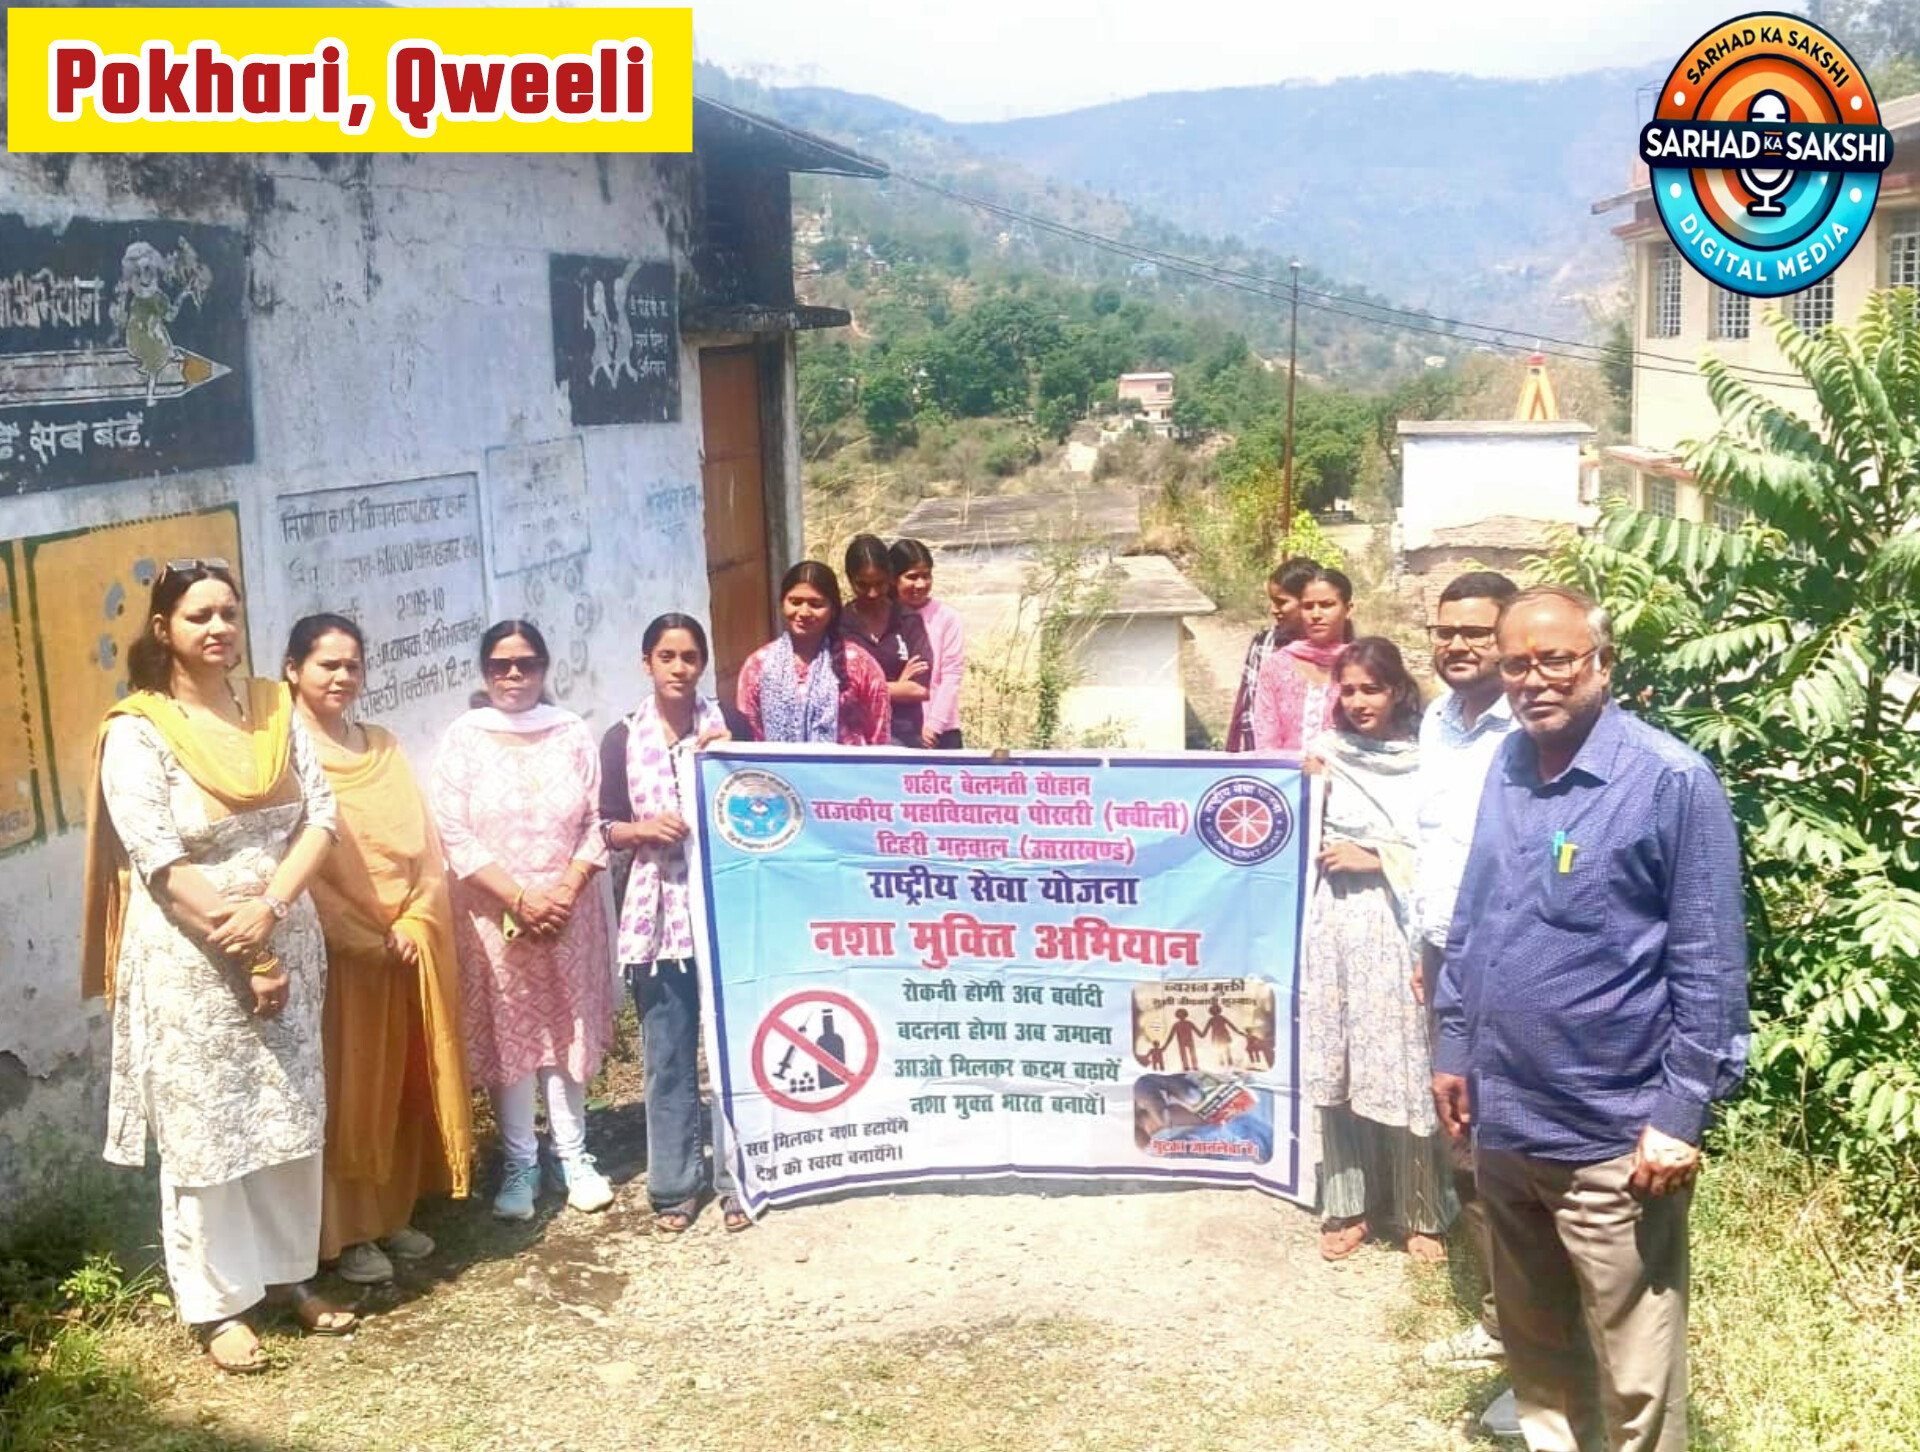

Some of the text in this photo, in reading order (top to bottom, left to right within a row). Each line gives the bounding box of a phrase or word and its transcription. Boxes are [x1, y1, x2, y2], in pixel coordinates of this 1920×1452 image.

[903, 773, 951, 796] शहीद
[1035, 771, 1090, 796] चौहान
[812, 798, 893, 822] राजकीय
[902, 798, 1019, 825] महाविद्यालय
[876, 831, 929, 856] टिहरी
[868, 865, 1140, 906] राष्ट्रीय सेवा योजना
[810, 913, 1202, 969] नशा मुक्ति अभियान
[902, 978, 1104, 1008] रोकनी होगी अब बर्बादी
[896, 1017, 1112, 1045] बदलना होगा अब जमाना
[894, 1054, 942, 1079] आओ
[949, 1053, 1014, 1078] मिलकर
[1020, 1059, 1067, 1079] कदम
[909, 1095, 947, 1115] नशा
[952, 1094, 994, 1120] मुक्त
[1001, 1093, 1044, 1114] भारत
[744, 1140, 770, 1157] सब
[773, 1127, 825, 1151] मिलकर
[829, 1123, 857, 1141] नशा
[782, 1156, 802, 1176] को
